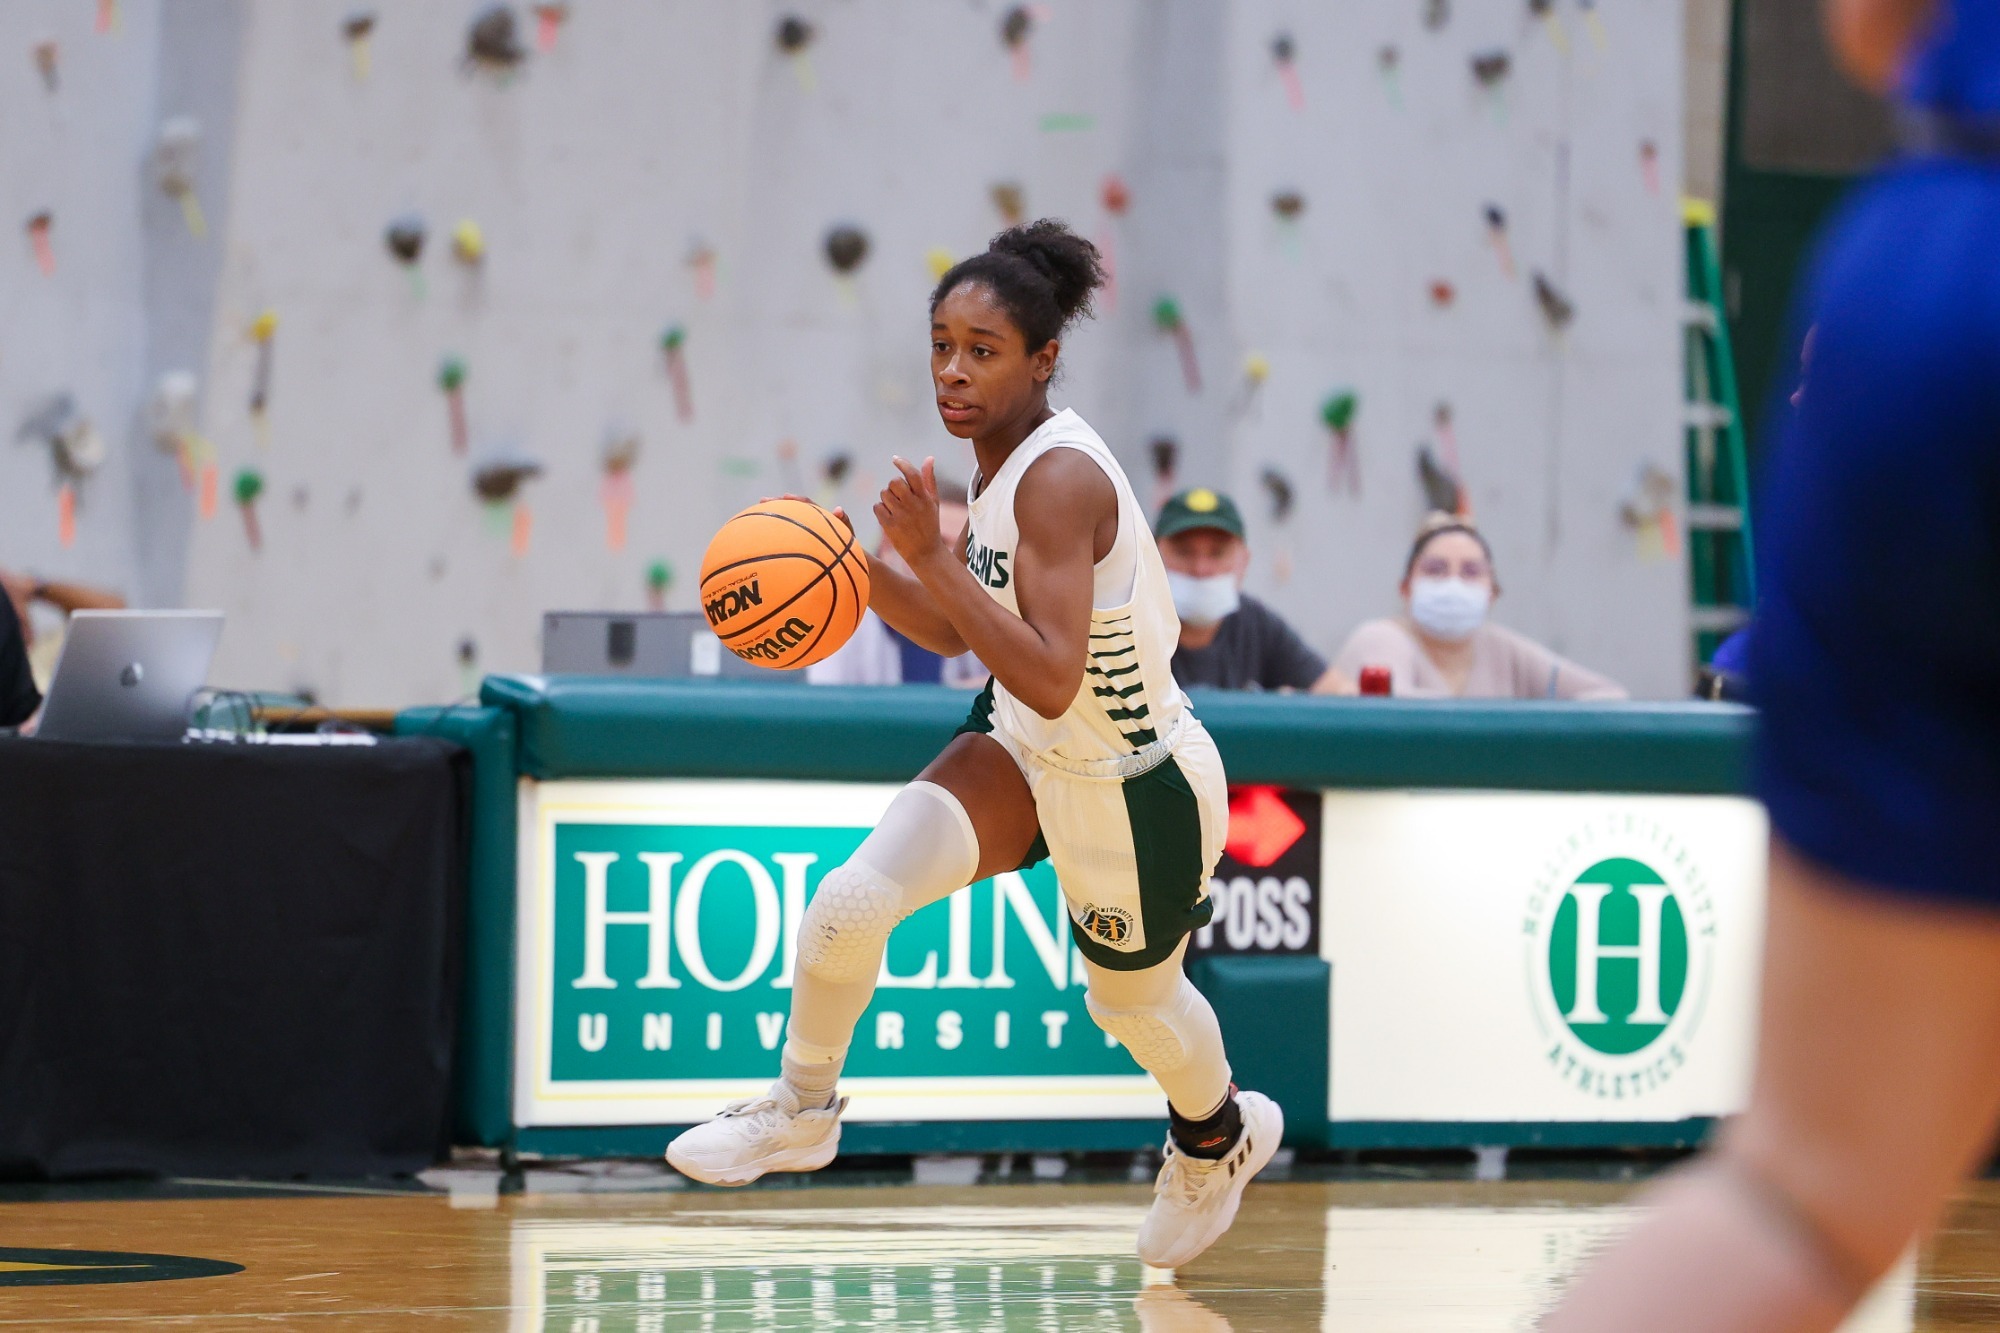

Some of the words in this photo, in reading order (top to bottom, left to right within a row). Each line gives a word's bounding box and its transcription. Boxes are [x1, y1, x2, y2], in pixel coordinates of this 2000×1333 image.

[705, 580, 762, 626] NCAA
[1196, 876, 1312, 950] POSS
[1565, 883, 1675, 1024] H
[577, 1009, 1120, 1053] UNIVRSIT
[1545, 1040, 1687, 1100] ATHLETICS
